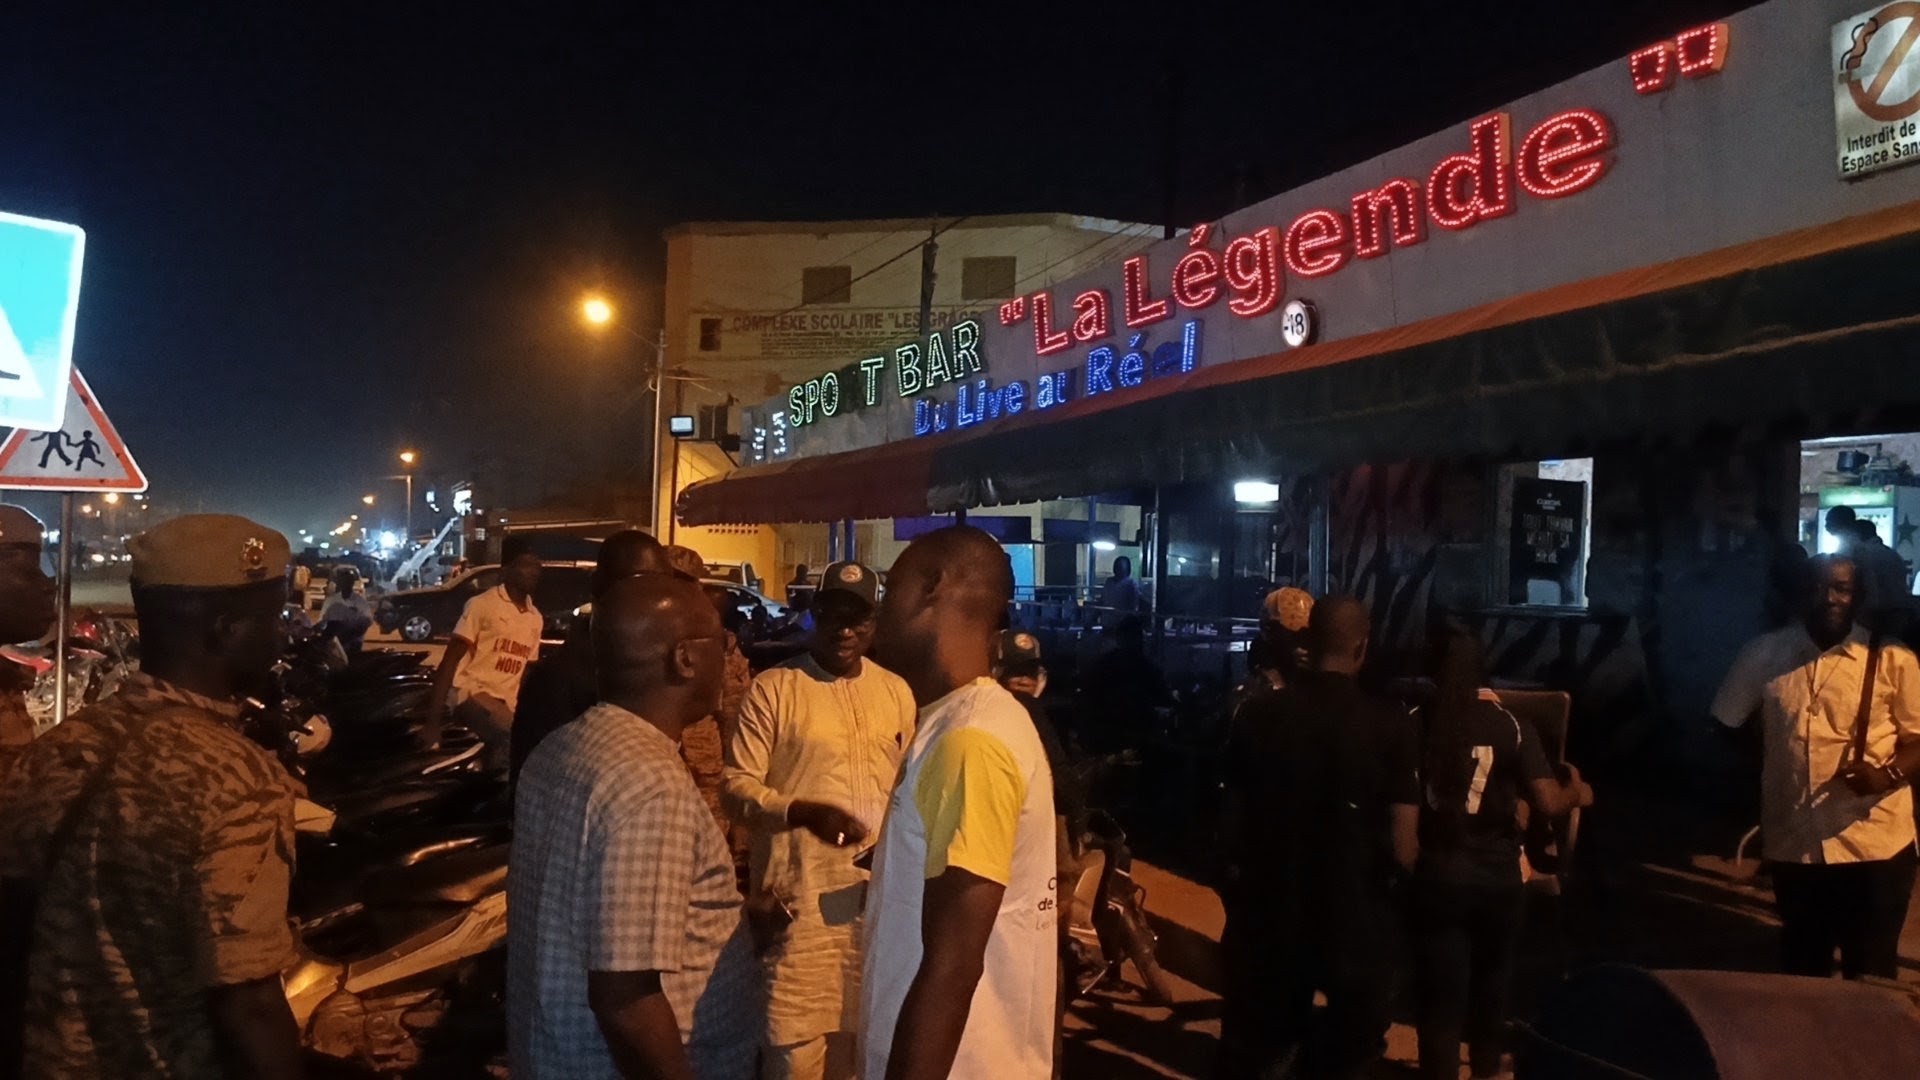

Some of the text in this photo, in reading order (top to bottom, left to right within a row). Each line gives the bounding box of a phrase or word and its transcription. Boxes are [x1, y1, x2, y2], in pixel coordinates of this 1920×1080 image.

[1847, 120, 1917, 153] Interdit de
[1842, 149, 1889, 173] Espace
[733, 312, 807, 332] COMPLEXE
[811, 310, 883, 331] SCOLAIRE
[895, 320, 982, 397] BAR
[957, 379, 1024, 426] Live
[1465, 745, 1494, 815] 7
[1037, 897, 1054, 912] de
